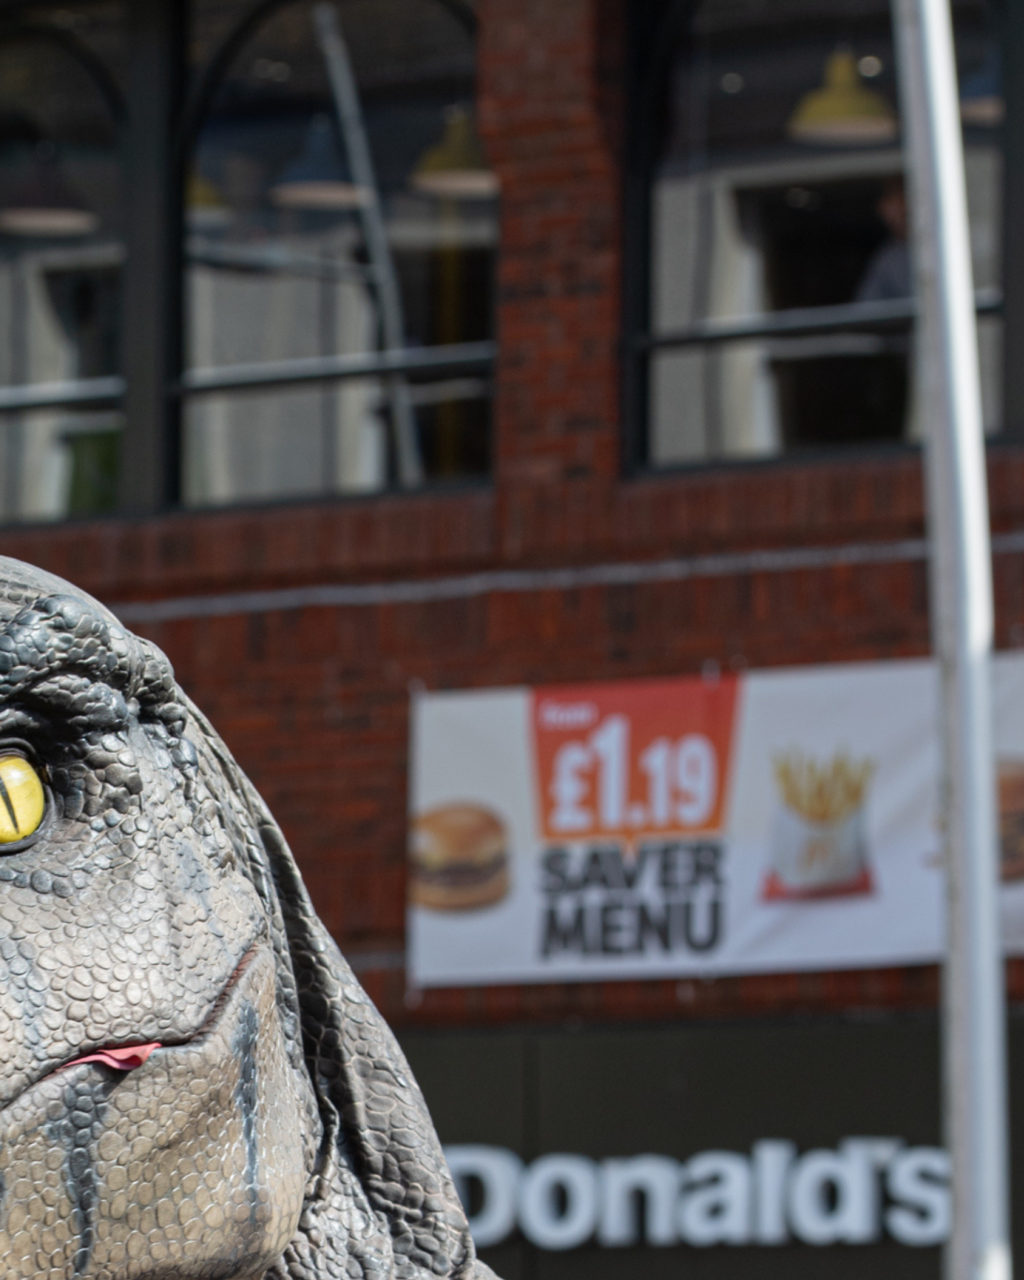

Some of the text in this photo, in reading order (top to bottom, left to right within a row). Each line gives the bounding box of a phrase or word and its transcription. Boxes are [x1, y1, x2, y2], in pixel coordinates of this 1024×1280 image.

[549, 714, 719, 832] £1.19
[542, 840, 724, 894] SAVER
[541, 897, 724, 960] MENU
